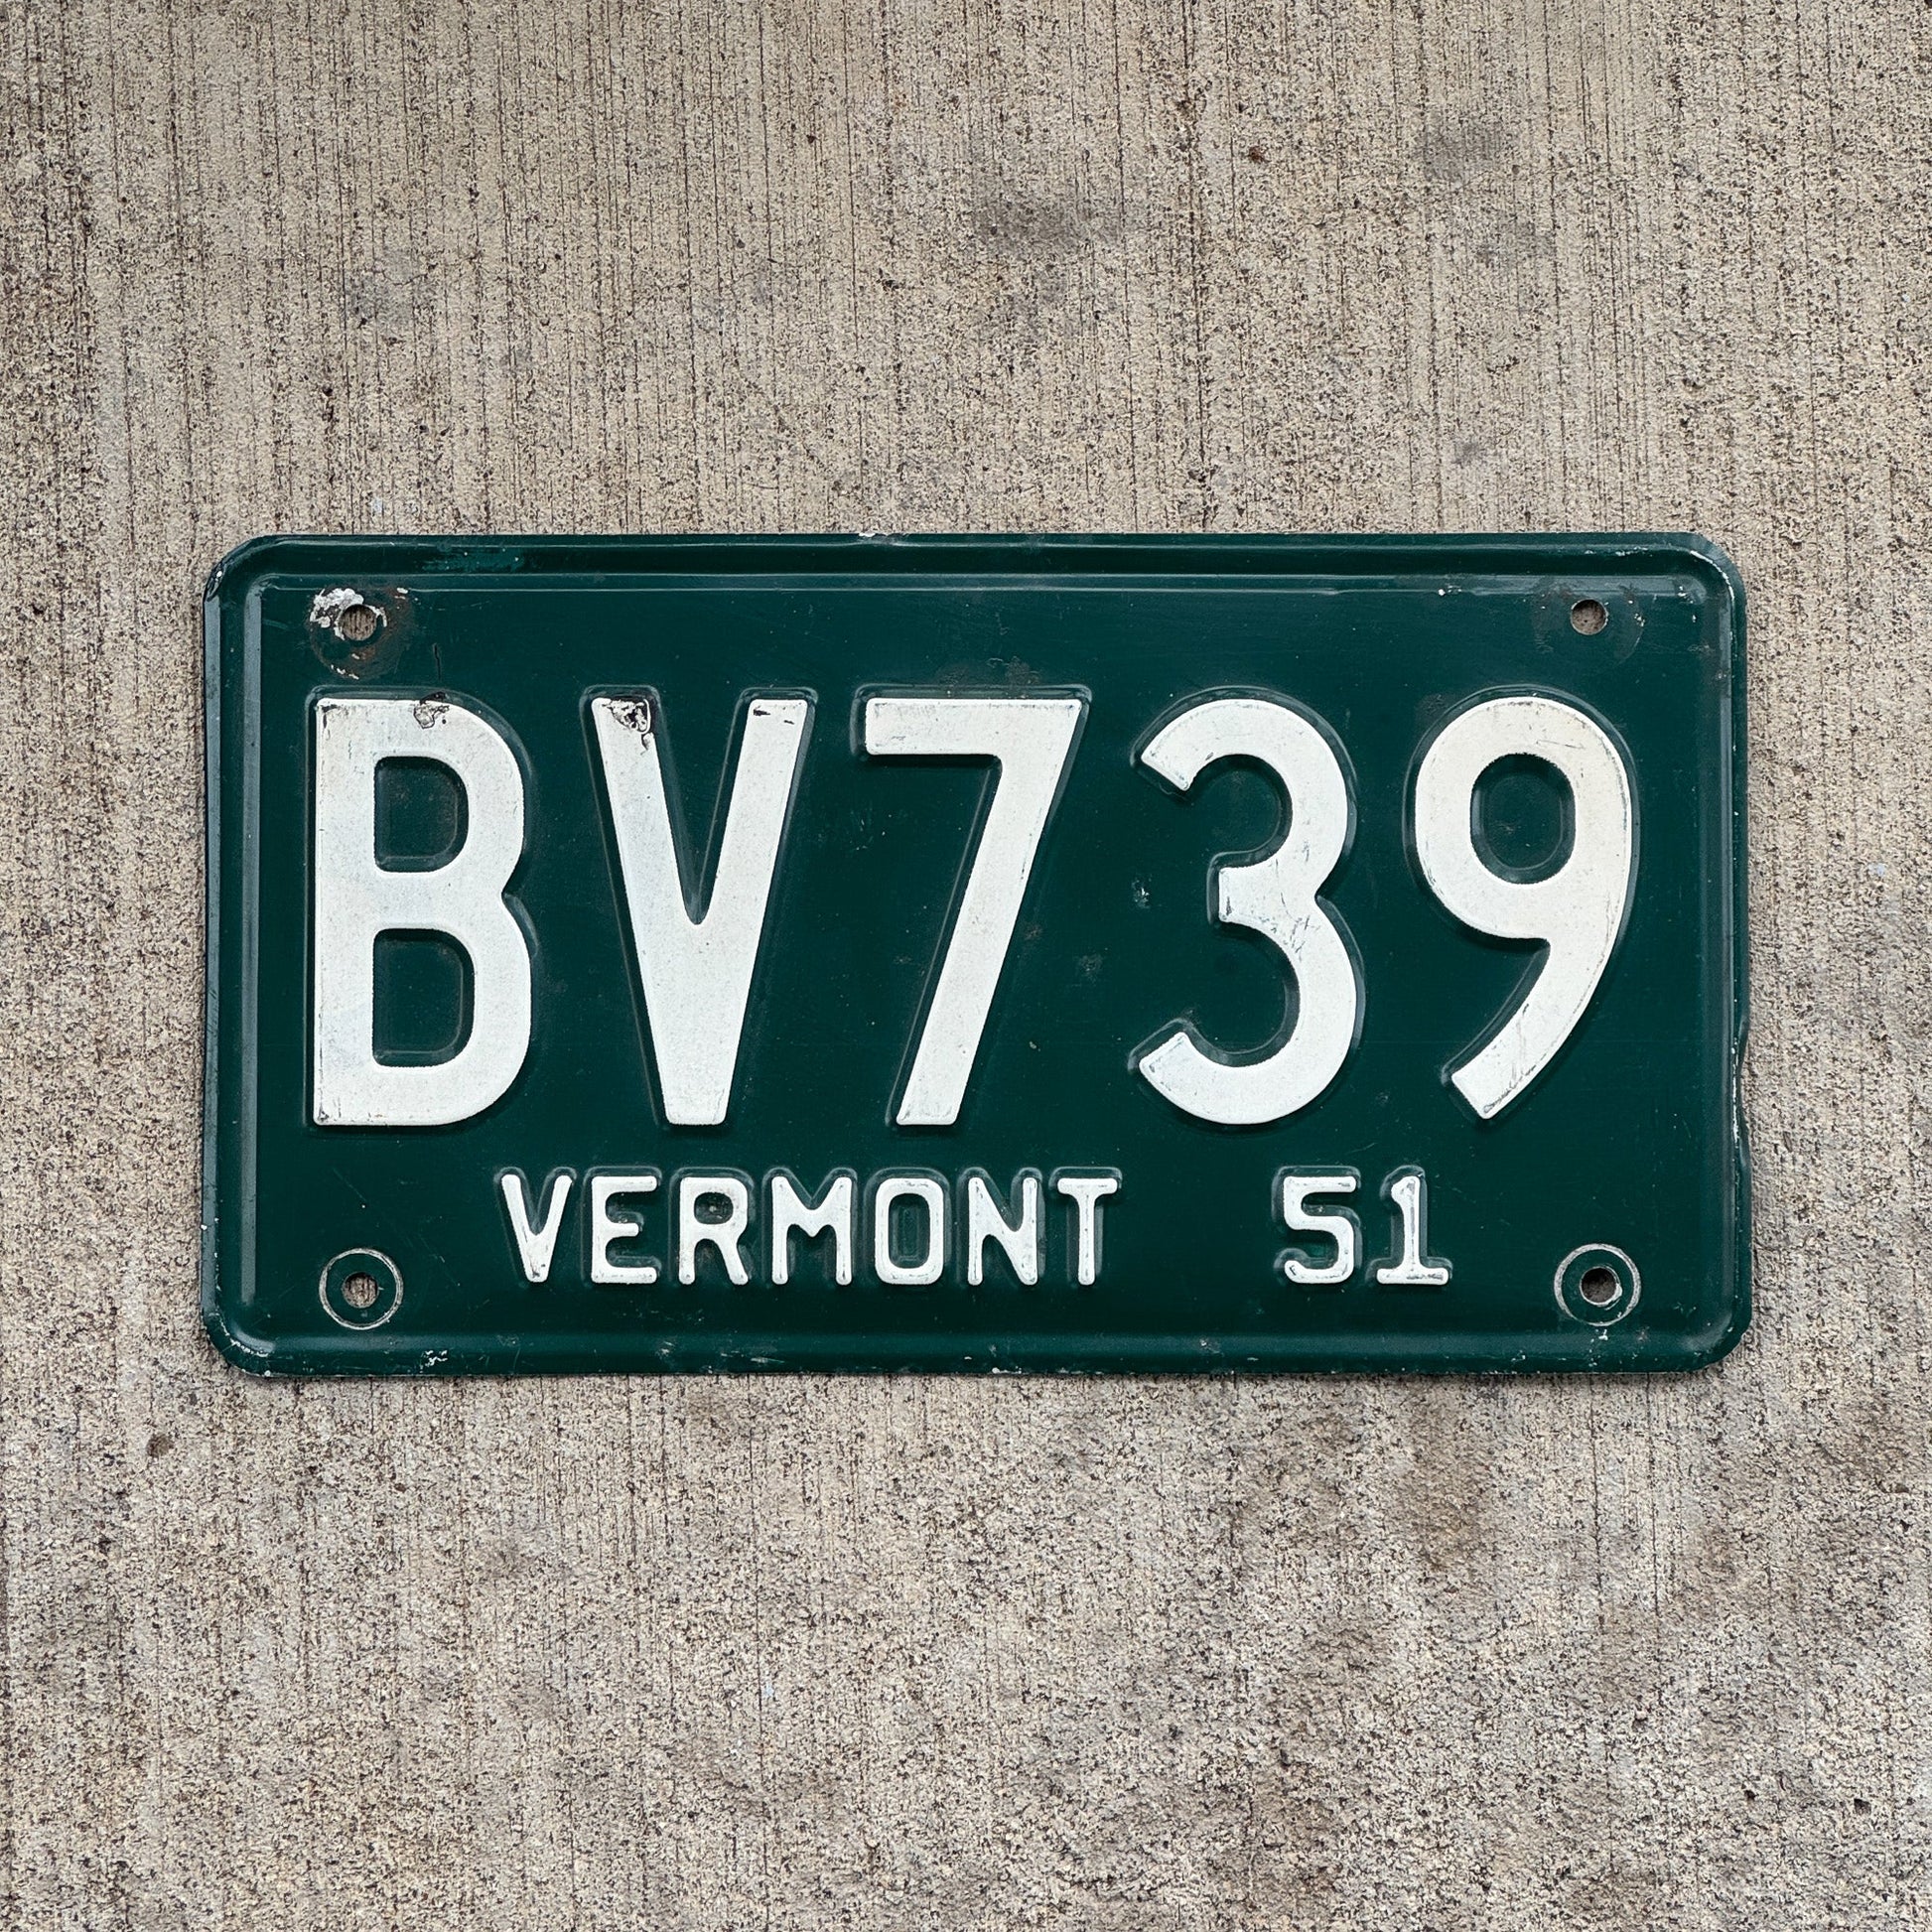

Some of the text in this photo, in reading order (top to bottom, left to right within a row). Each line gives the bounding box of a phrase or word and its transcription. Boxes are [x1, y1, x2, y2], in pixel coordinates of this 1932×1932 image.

[312, 696, 1634, 1126] BV739
[499, 1173, 1450, 1286] VERMONT 51
